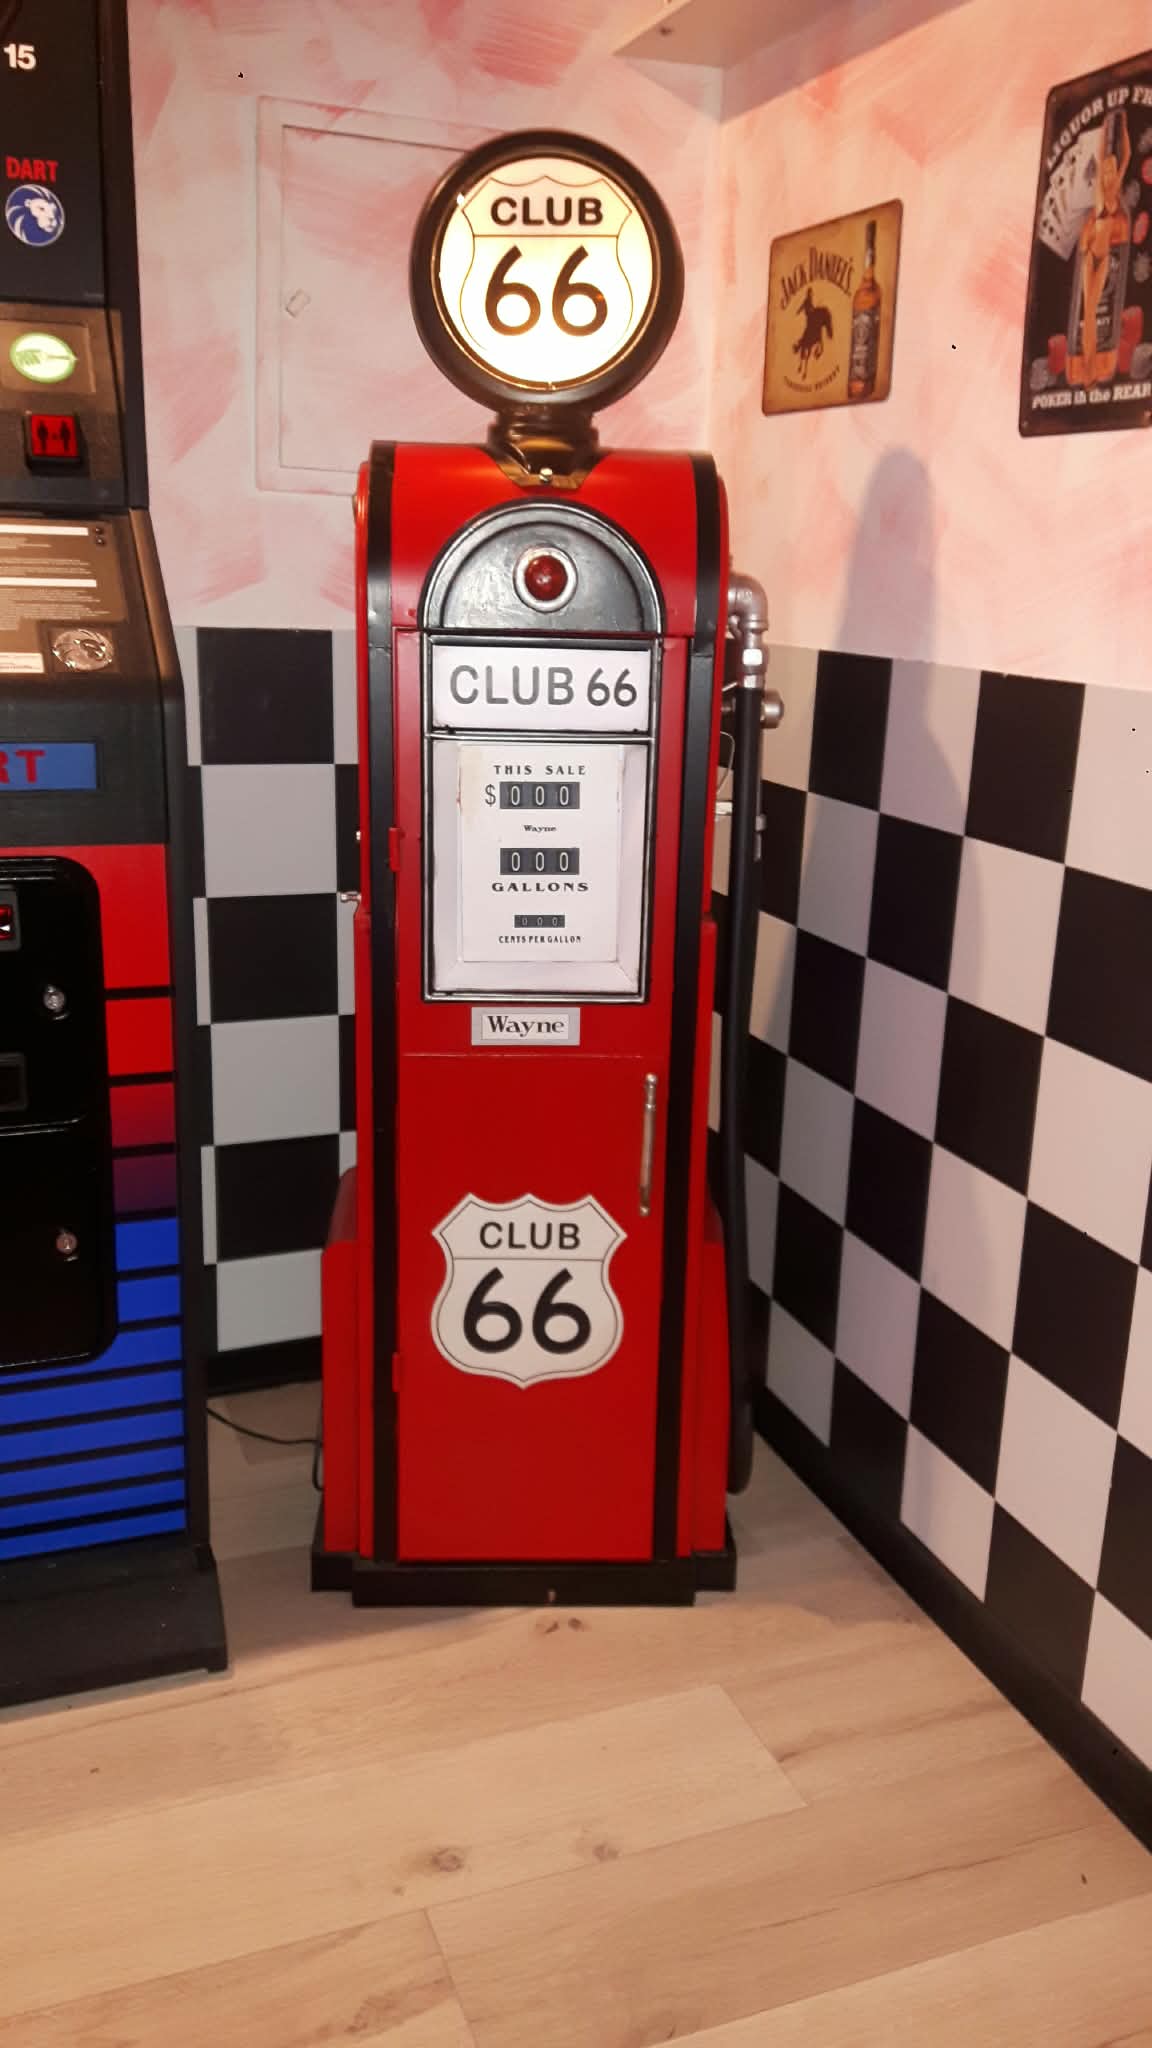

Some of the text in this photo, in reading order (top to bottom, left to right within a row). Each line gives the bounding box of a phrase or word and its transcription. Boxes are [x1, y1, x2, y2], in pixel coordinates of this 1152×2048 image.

[4, 44, 36, 70] 15
[1047, 98, 1104, 169] LIQUOR
[1107, 87, 1130, 107] UP
[5, 156, 59, 182] DART
[490, 197, 604, 226] CLUB
[485, 245, 608, 337] 66
[1032, 381, 1152, 409] POKER in the REAR
[450, 665, 638, 707] CLUB 66
[493, 765, 586, 775] THIS SALE
[523, 824, 557, 833] Wayne
[491, 882, 589, 892] GALLONS
[498, 935, 582, 944] CENTS PER GALLON
[486, 1015, 566, 1038] Wayne
[479, 1222, 581, 1250] CLUB
[463, 1266, 592, 1355] 66
